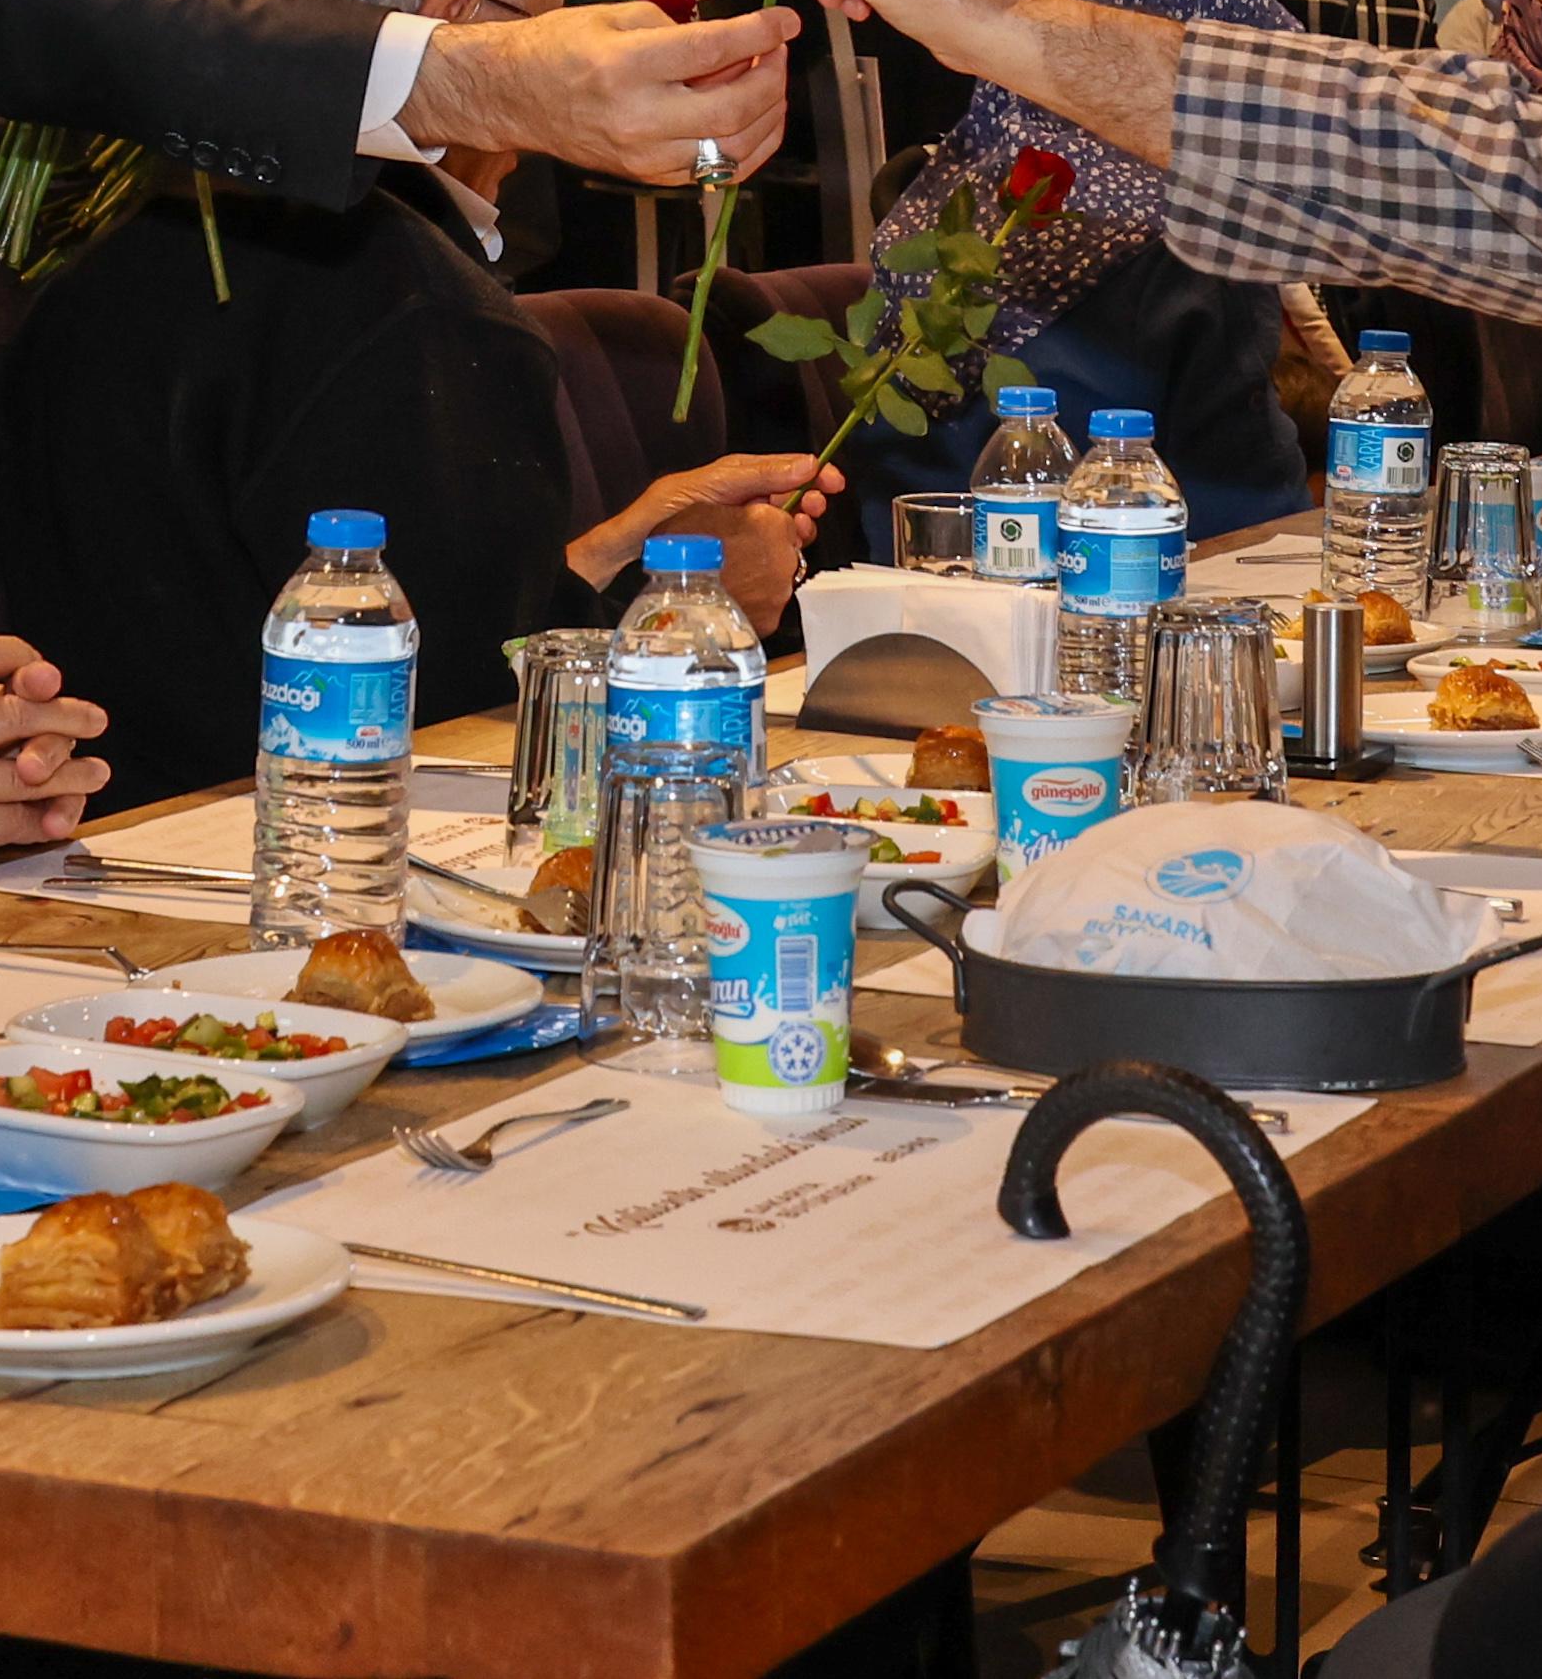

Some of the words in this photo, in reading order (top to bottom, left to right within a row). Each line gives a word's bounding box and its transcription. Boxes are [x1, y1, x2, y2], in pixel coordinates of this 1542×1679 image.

[1057, 549, 1087, 574] zdağı
[608, 711, 647, 742] zdağı
[1031, 782, 1101, 801] güneşoğlu
[1114, 904, 1213, 951] SAKARYA
[713, 979, 750, 1002] ran
